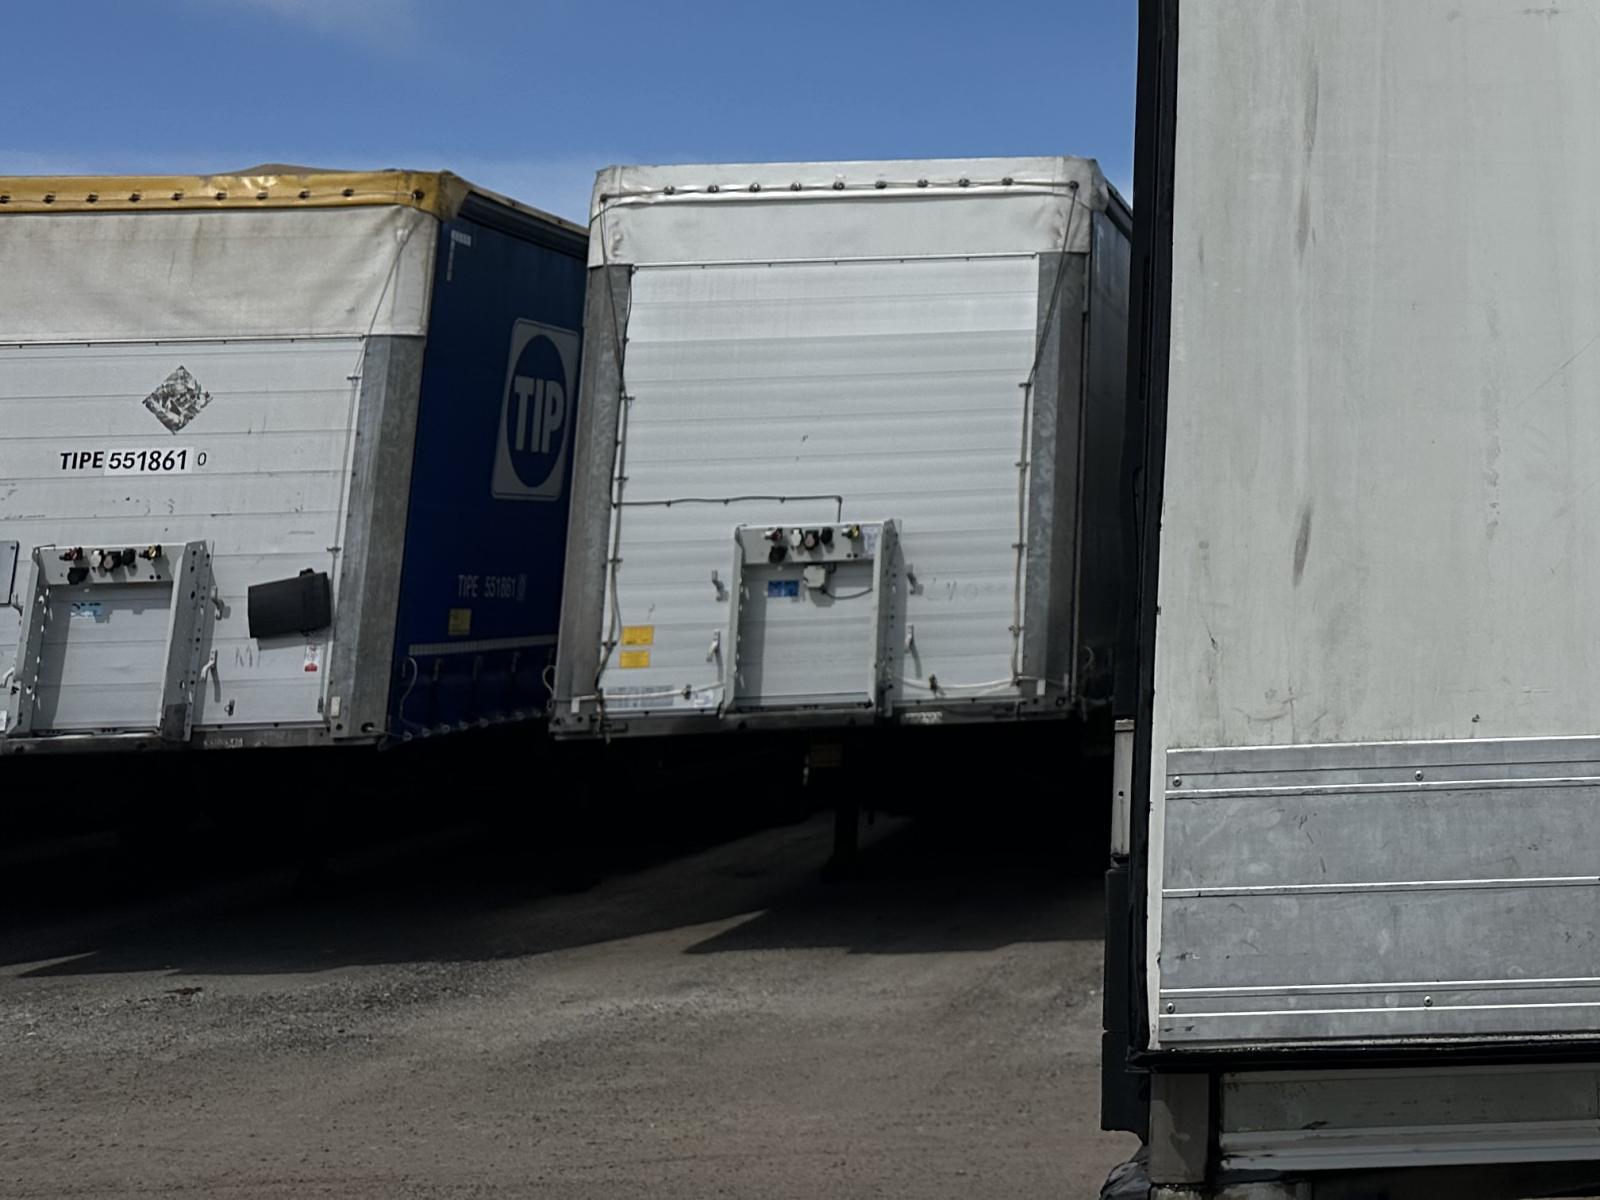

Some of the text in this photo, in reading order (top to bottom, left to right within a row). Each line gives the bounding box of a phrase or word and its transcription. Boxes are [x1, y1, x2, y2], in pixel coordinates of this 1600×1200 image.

[514, 375, 565, 453] TIP
[60, 451, 104, 470] TIPE
[108, 450, 187, 471] 551861
[458, 574, 480, 598] TIPE
